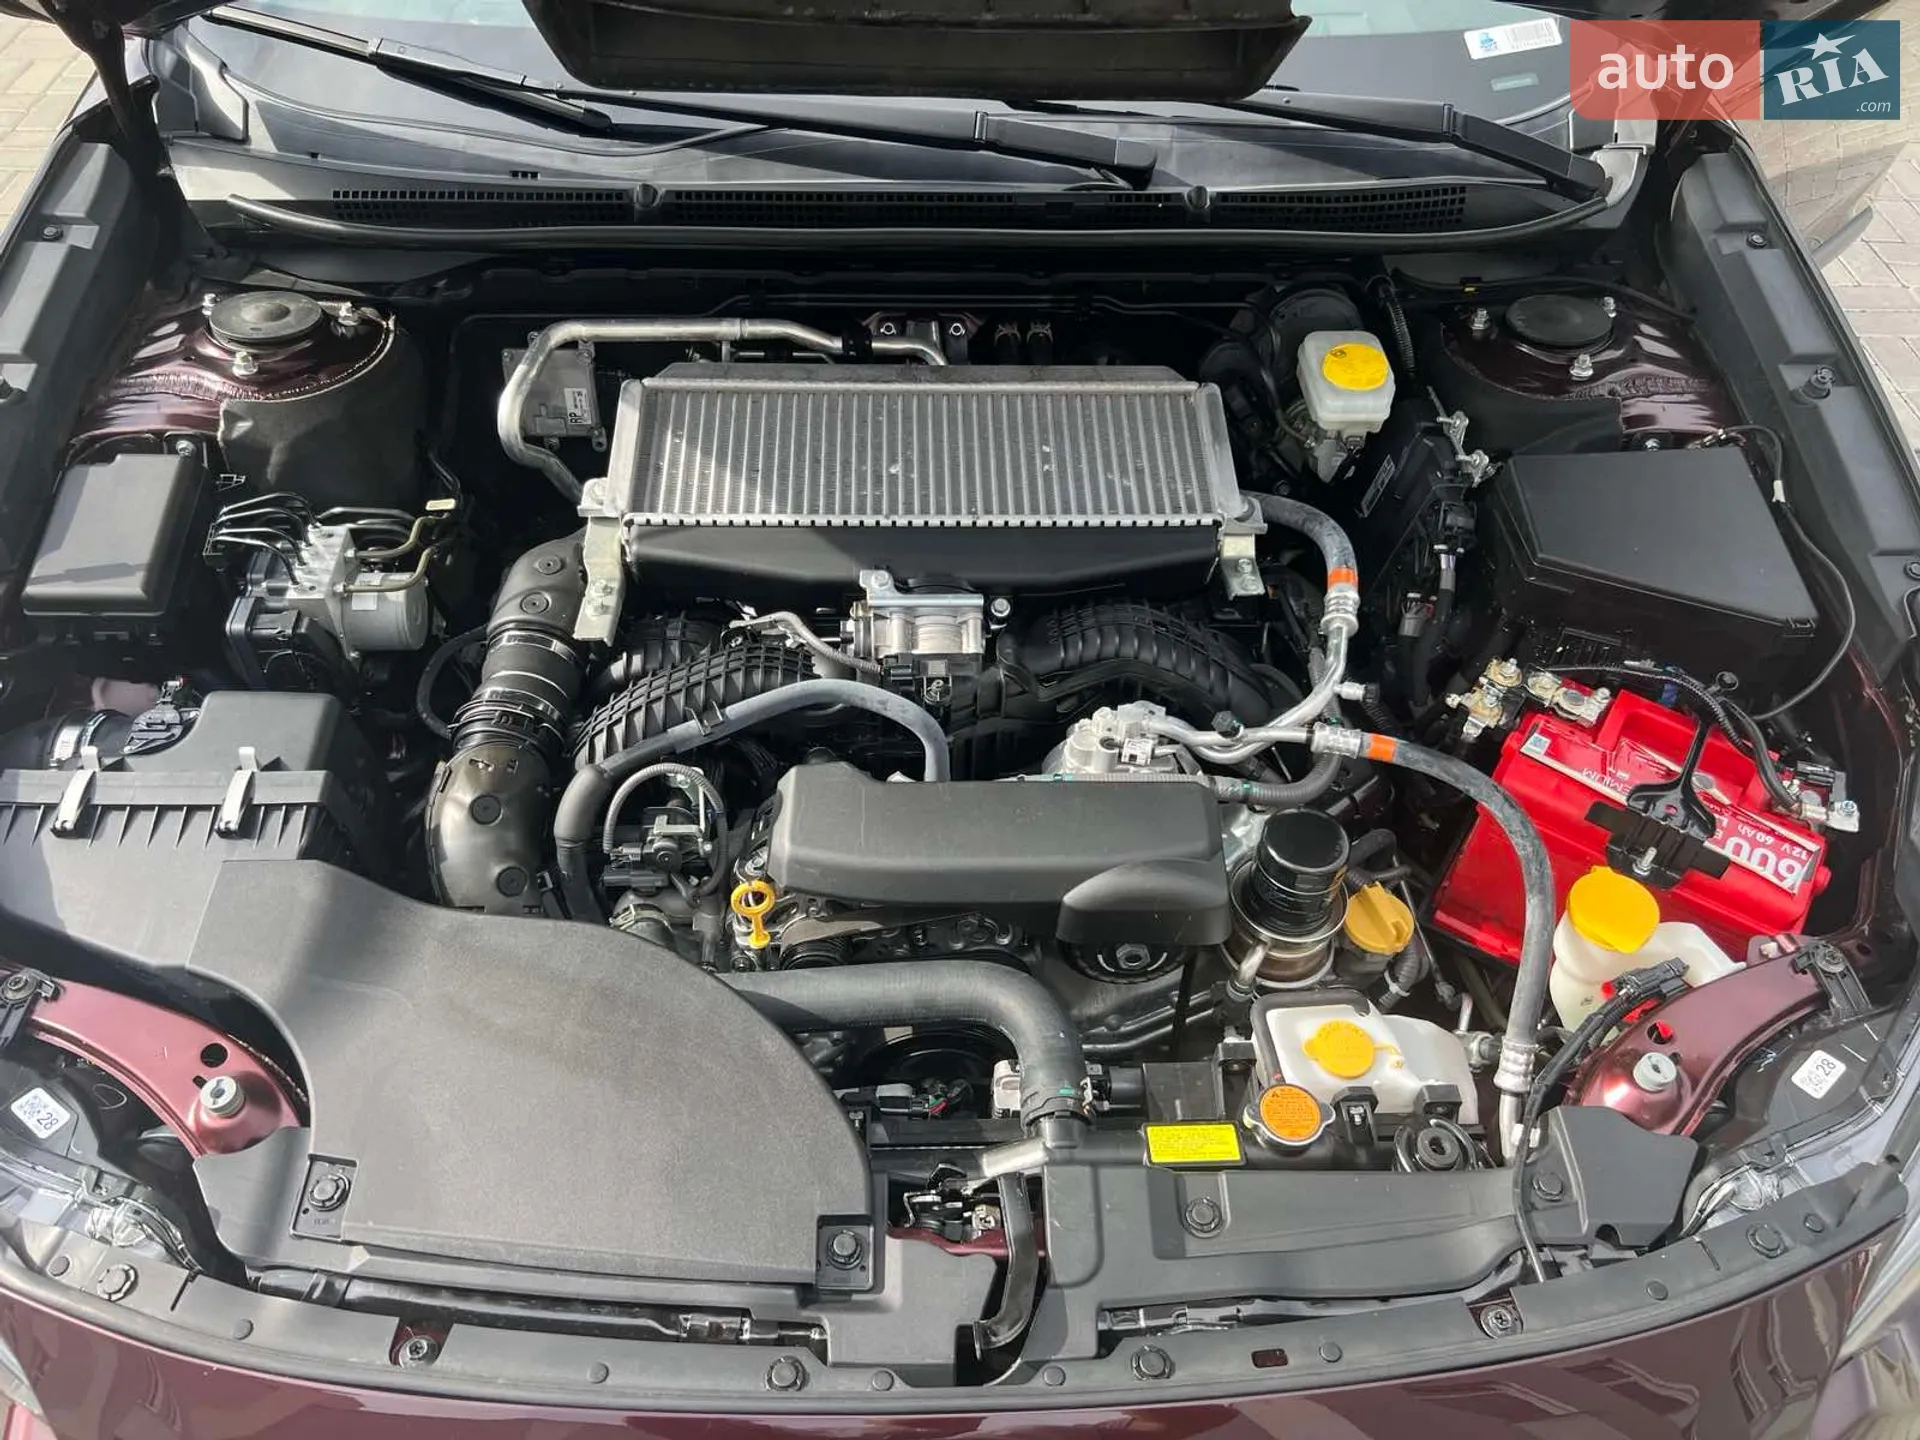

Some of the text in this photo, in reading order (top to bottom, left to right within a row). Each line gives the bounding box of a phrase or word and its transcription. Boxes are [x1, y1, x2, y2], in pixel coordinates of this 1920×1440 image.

[1583, 768, 1632, 795] EMIUM
[1724, 836, 1803, 887] 600
[1815, 1059, 1836, 1076] 28
[37, 1113, 59, 1130] 28
